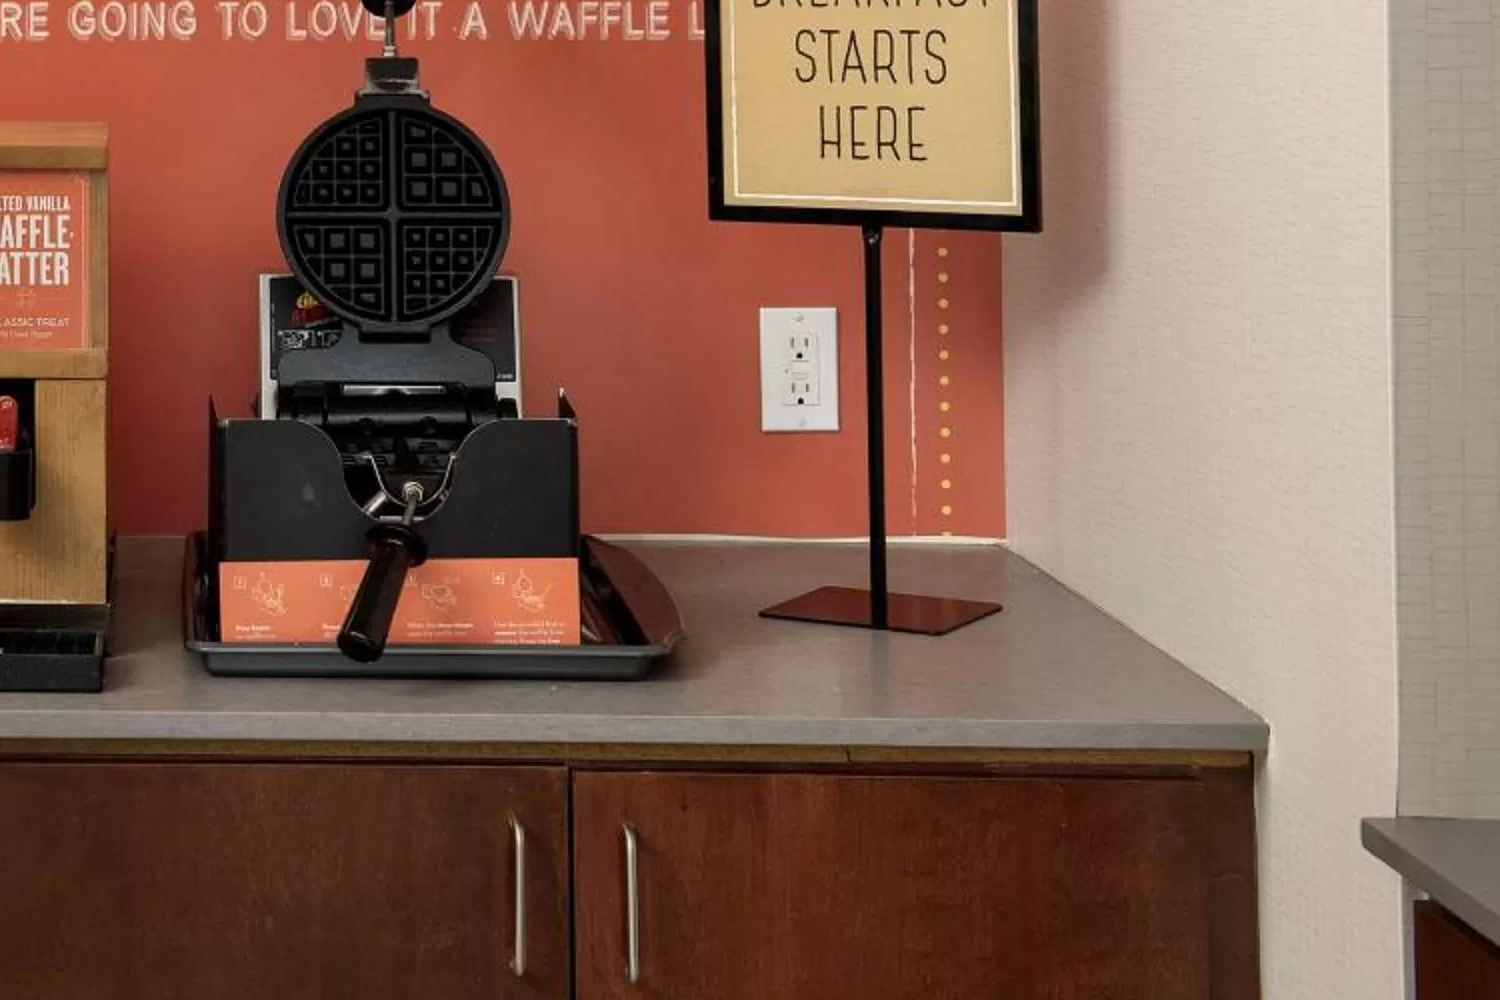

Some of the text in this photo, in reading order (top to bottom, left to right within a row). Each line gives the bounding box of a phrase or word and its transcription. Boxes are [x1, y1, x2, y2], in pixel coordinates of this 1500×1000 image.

[67, 0, 197, 42] GOING
[214, 0, 269, 41] TO
[407, 0, 443, 41] IT
[453, 1, 488, 41] A
[507, 0, 671, 41] WAFFLE
[795, 29, 947, 85] STARTS
[819, 105, 929, 161] HERE
[25, 196, 71, 212] VANILLA
[36, 316, 70, 327] TREAT
